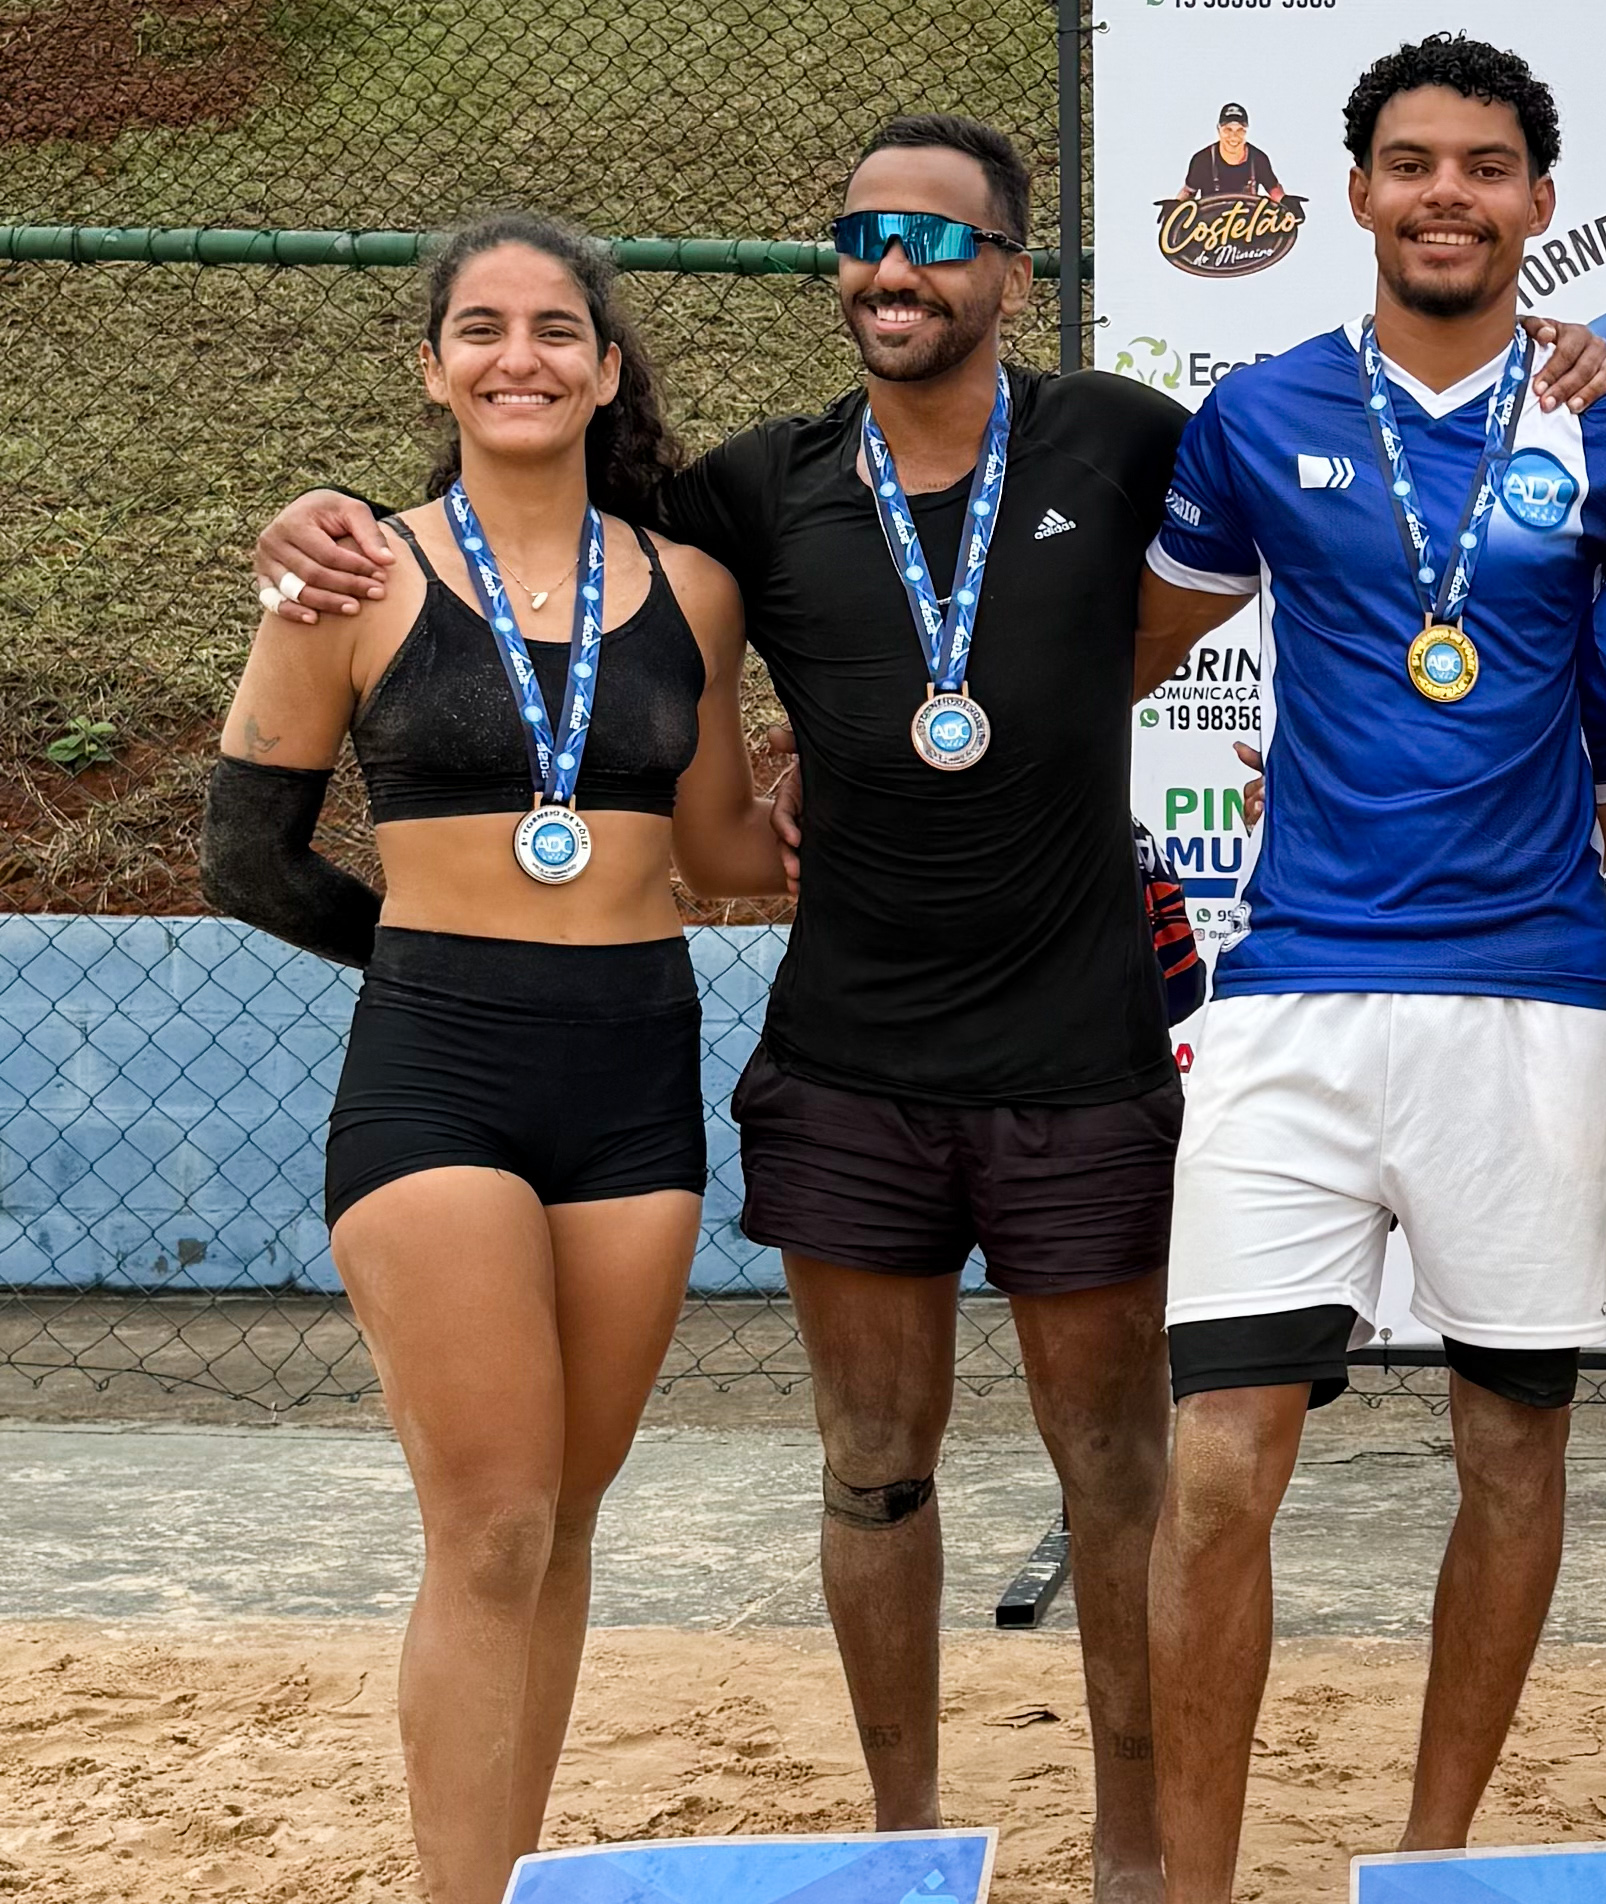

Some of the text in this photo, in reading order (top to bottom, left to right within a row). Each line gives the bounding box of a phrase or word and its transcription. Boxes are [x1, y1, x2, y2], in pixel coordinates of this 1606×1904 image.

[1161, 198, 1303, 254] Costelão
[1504, 473, 1574, 508] ADC
[1033, 520, 1077, 541] adidas
[1171, 647, 1261, 682] BRIN
[1149, 685, 1260, 702] OMUNICAÇÃ
[1165, 705, 1261, 730] 19 98358
[932, 723, 969, 740] ADC
[1165, 788, 1246, 831] PIN
[535, 835, 573, 854] ADC
